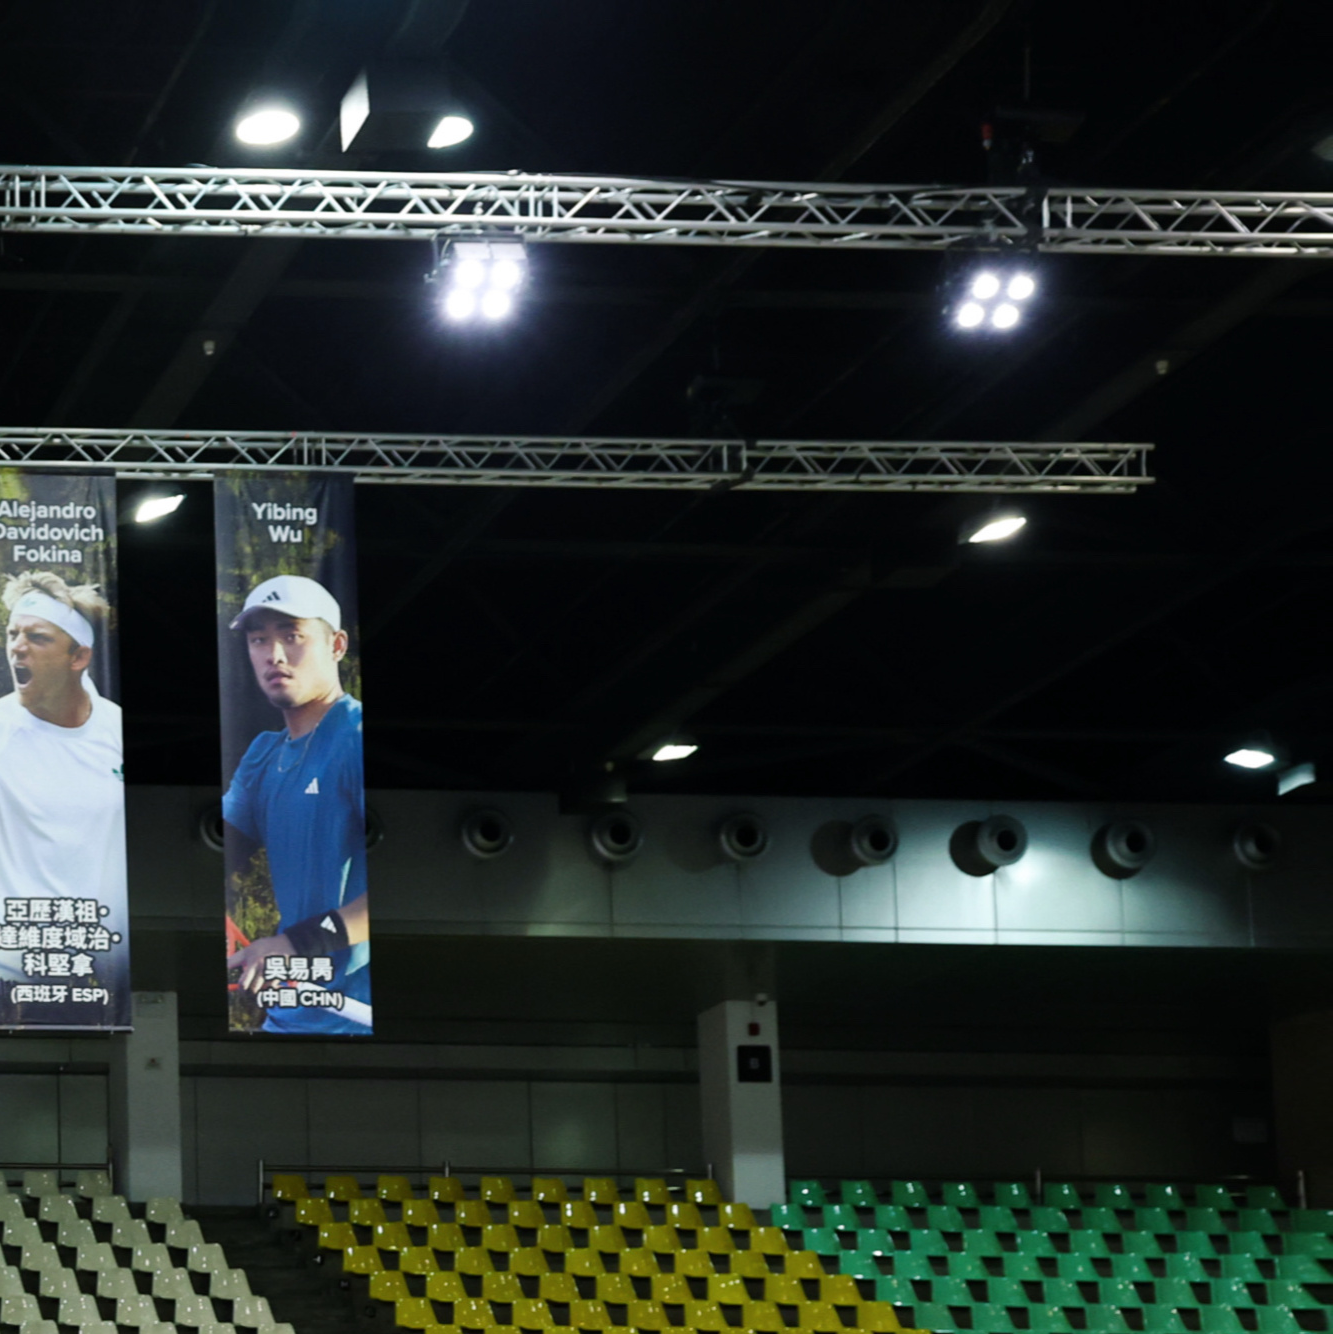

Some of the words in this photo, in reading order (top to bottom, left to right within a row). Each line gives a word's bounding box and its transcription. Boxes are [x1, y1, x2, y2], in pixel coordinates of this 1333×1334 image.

[252, 502, 317, 525] Yibing
[269, 525, 302, 544] Wu
[13, 544, 82, 564] Fokina
[24, 952, 94, 977] 科堅拿
[10, 985, 68, 1004] (西班牙
[72, 987, 109, 1005] ESP)
[257, 988, 298, 1007] (中國
[299, 991, 344, 1010] CHN)
